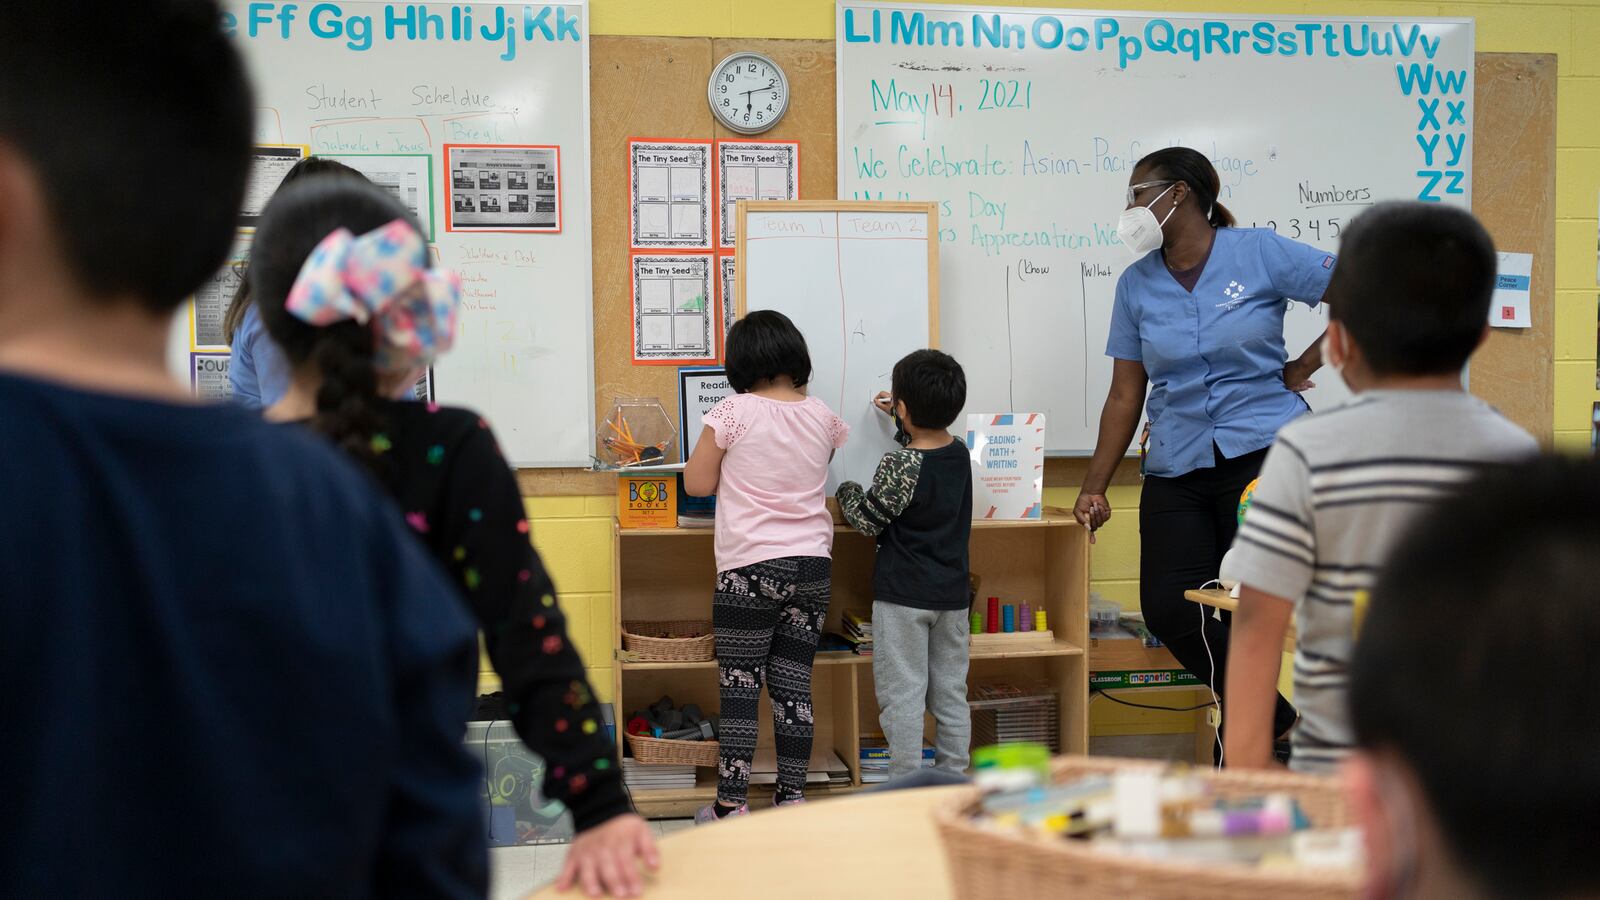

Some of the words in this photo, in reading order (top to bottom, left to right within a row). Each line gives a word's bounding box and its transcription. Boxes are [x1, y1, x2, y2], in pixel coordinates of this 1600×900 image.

[248, 3, 298, 39] Ff
[308, 3, 373, 51] Gg
[385, 5, 444, 41] Hh
[480, 6, 516, 62] Jj
[523, 6, 581, 42] Kk
[891, 11, 964, 47] Mm
[972, 14, 1026, 49] Nn
[1031, 16, 1089, 51] Oo
[1095, 18, 1143, 69] Pp
[1144, 19, 1200, 61] Qq
[1203, 22, 1249, 54] Rr
[1252, 22, 1298, 56] Ss
[1295, 24, 1340, 56] Tt
[1343, 24, 1393, 57] Uu
[1393, 24, 1440, 59] Vv
[736, 66, 741, 74] 11
[748, 64, 757, 72] 12
[726, 74, 735, 82] 10
[1396, 63, 1467, 95] Ww
[769, 79, 776, 88] 2
[721, 85, 727, 93] 9
[306, 84, 382, 110] Student
[411, 86, 496, 108] Scheldue
[771, 92, 778, 100] 3
[723, 98, 730, 106] 8
[732, 108, 738, 116] 7
[766, 104, 772, 112] 4
[871, 79, 929, 139] May
[978, 79, 1031, 110] 2021
[744, 113, 750, 121] 6
[756, 112, 763, 120] 5
[1417, 98, 1465, 131] Xx
[1416, 133, 1465, 166] Yy
[653, 155, 668, 163] Tiny
[669, 155, 689, 163] Seed
[741, 155, 755, 163] Tiny
[854, 146, 887, 179] We
[898, 144, 1014, 178] Celebrate:
[1022, 137, 1141, 176] Asian-Pacif
[1416, 170, 1464, 201] Zz
[1298, 181, 1371, 204] Numbers
[969, 191, 1006, 231] Day
[757, 216, 804, 233] Team
[819, 219, 825, 234] 1
[848, 218, 902, 233] Team
[908, 218, 922, 232] 2
[1289, 218, 1301, 239] 3
[1309, 220, 1320, 240] 4
[1328, 218, 1340, 238] 5
[971, 223, 1091, 257] Appreciation
[1093, 222, 1124, 246] We
[655, 267, 670, 275] Tiny
[701, 381, 731, 389] Readin
[699, 395, 726, 404] Respo
[989, 448, 1009, 456] MATH
[986, 460, 1018, 469] WRITING
[629, 481, 668, 502] BOB
[1130, 673, 1170, 683] magnetic
